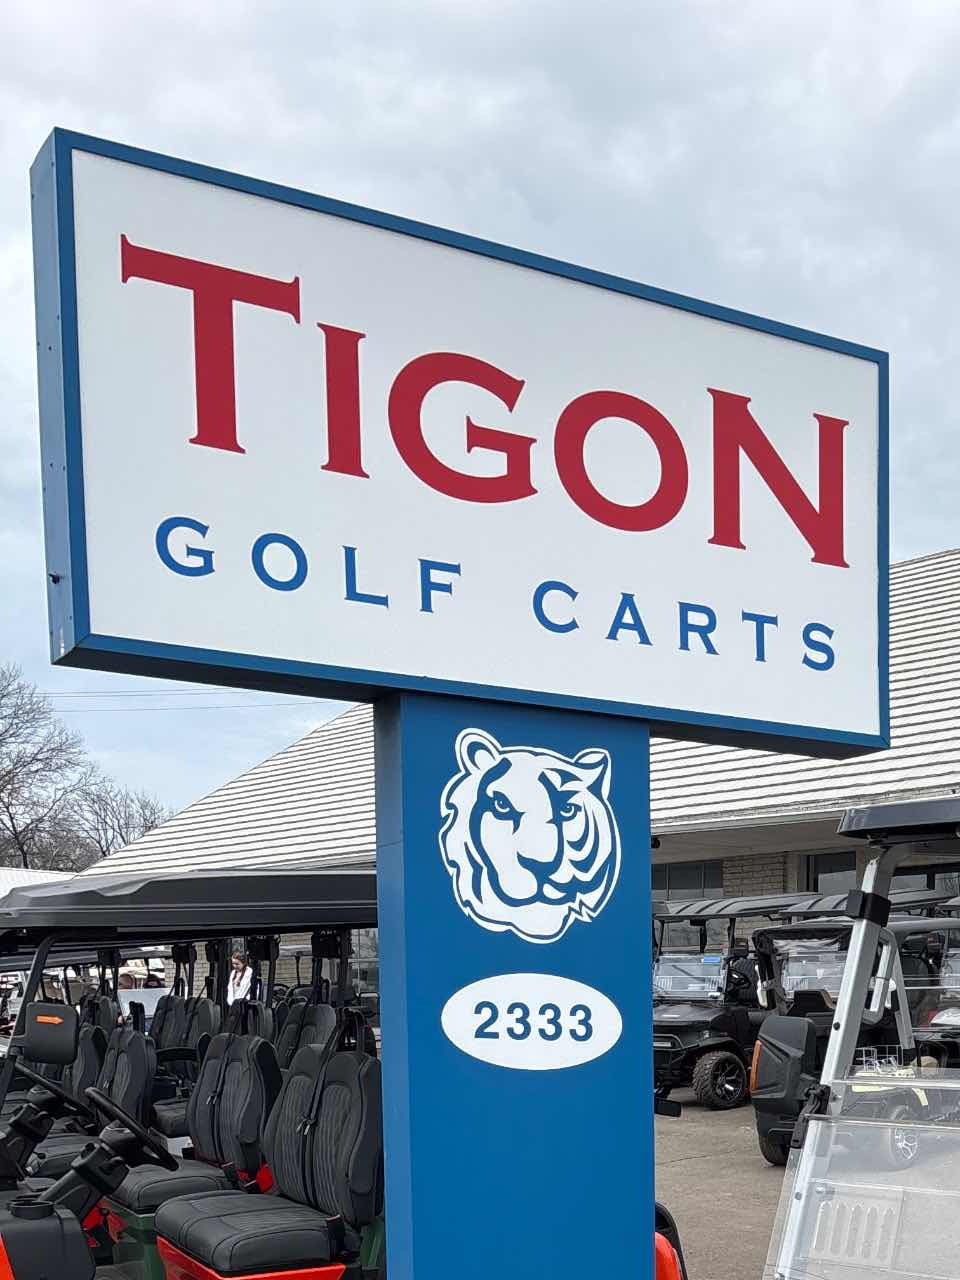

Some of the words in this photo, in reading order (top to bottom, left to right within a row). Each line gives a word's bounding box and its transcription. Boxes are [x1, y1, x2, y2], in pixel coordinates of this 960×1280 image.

[121, 235, 848, 568] TIGON
[155, 516, 462, 613] GOLF
[532, 580, 838, 673] CARTS
[474, 1000, 593, 1042] 2333
